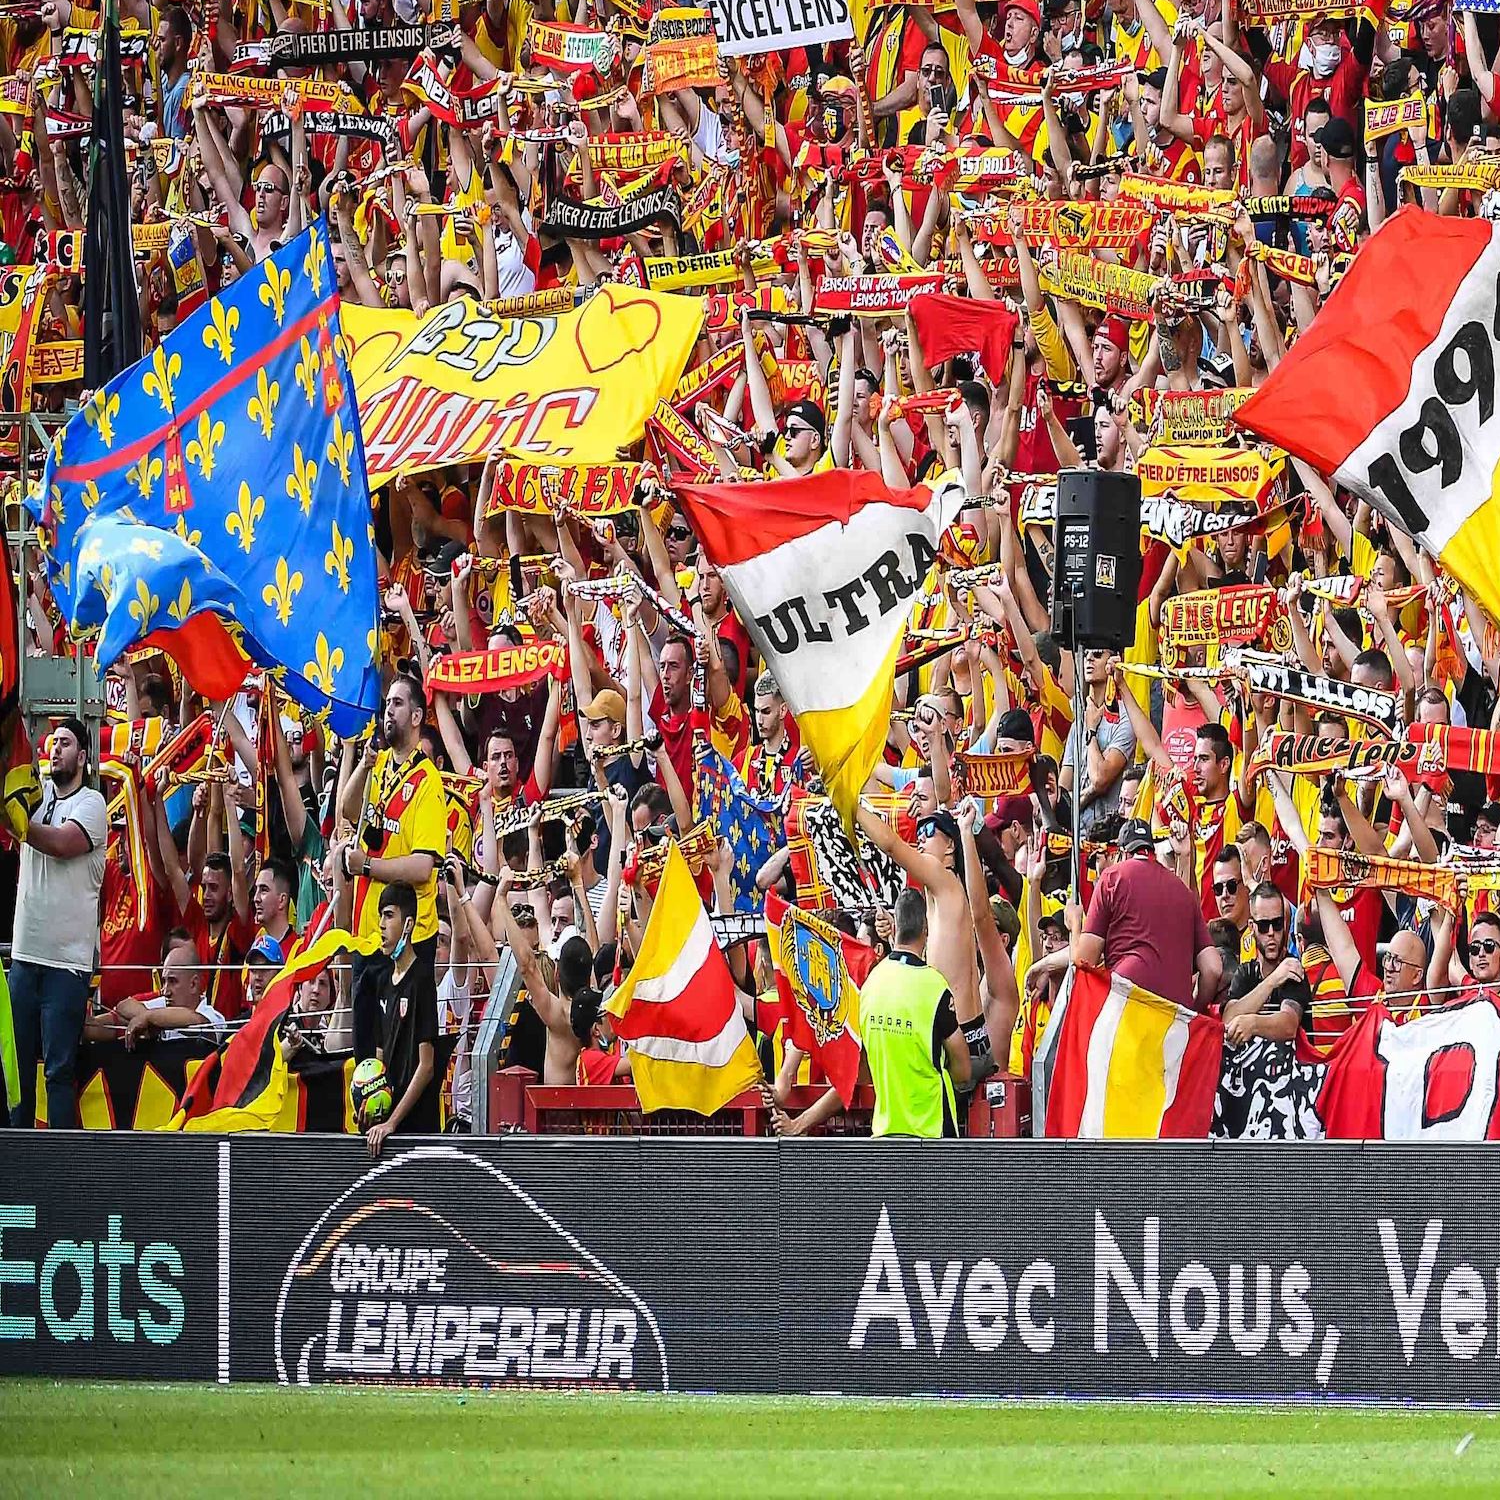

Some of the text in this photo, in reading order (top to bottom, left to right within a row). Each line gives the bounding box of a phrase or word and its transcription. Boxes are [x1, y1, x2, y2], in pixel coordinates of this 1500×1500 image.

[300, 29, 423, 58] FIER D ETRE LENSOIS
[248, 76, 336, 98] CLUB DE LENS
[1400, 99, 1423, 123] DE
[556, 192, 662, 227] FIER ETRE LENSOIS
[649, 259, 675, 280] FIER
[820, 276, 900, 293] LENSOIS UN JOUR
[850, 288, 888, 307] LENSOIS
[1208, 464, 1259, 482] LENSOIS
[1064, 533, 1089, 548] PS-12
[756, 534, 940, 655] ULTRA
[1302, 675, 1395, 718] LILLOIS
[1275, 736, 1413, 769] Allez Lens
[869, 1015, 913, 1031] AGORA
[0, 1204, 185, 1344] Eats
[330, 1244, 449, 1294] GROUPE
[847, 1203, 1056, 1358] Avec
[1093, 1209, 1342, 1389] Nous,
[323, 1300, 639, 1378] LEMPEREUR
